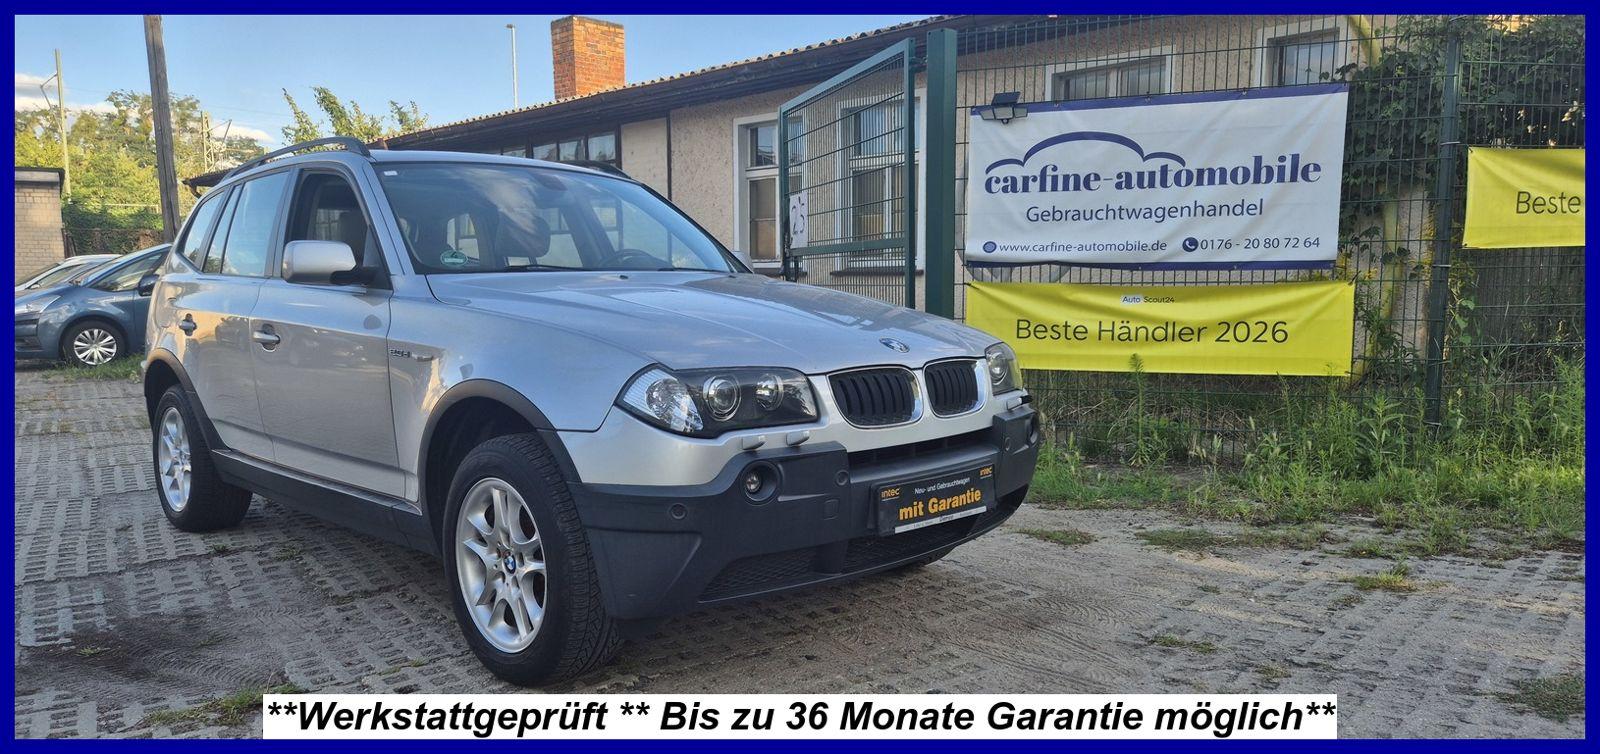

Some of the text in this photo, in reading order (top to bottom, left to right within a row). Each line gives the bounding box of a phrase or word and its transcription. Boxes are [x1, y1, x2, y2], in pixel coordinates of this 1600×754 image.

[984, 153, 1322, 195] carfine-automobile
[1026, 198, 1264, 224] Gebrauchtwagenhandel
[1515, 191, 1582, 214] Beste
[999, 239, 1168, 252] www.carfine-automobile.de
[1200, 239, 1233, 250] 0176
[1243, 238, 1260, 249] 20
[1263, 238, 1280, 249] 80
[1284, 237, 1300, 248] 72
[1303, 237, 1321, 248] 64
[1016, 319, 1289, 343] Beste Händler 2026
[899, 501, 924, 520] mit
[928, 488, 982, 514] Garantie
